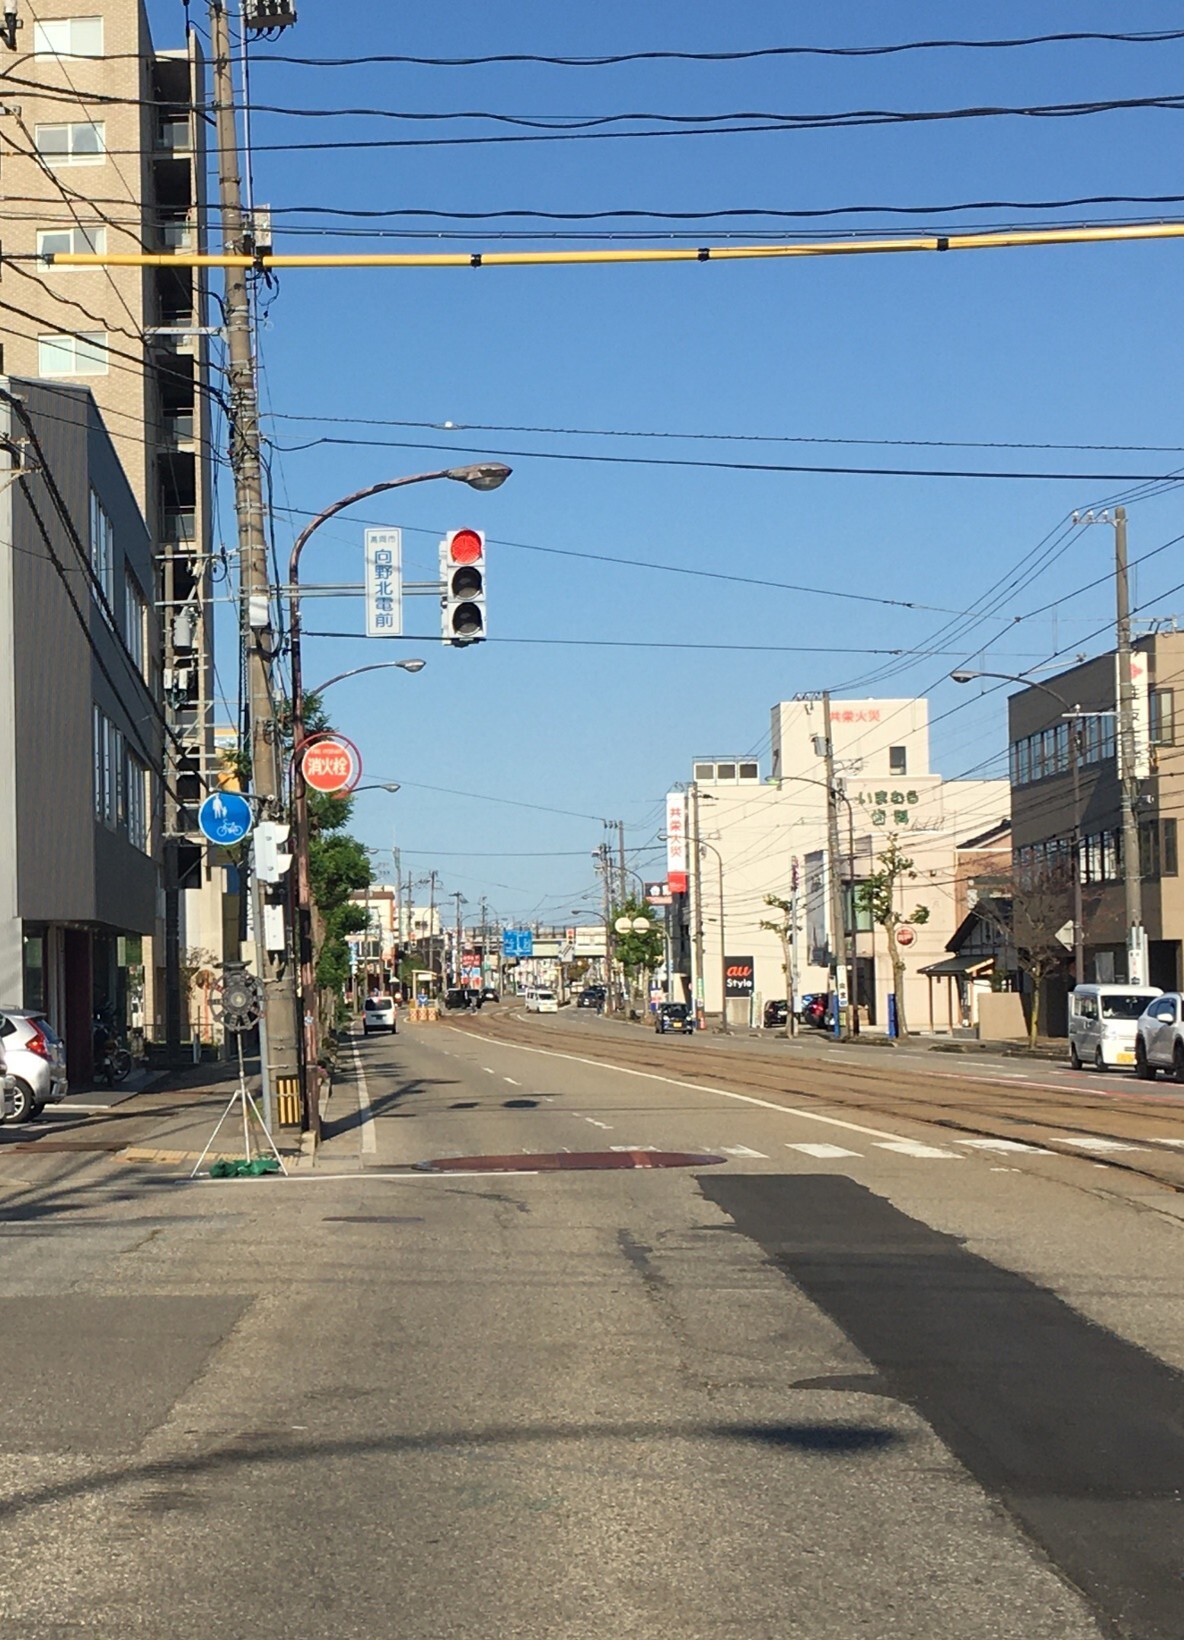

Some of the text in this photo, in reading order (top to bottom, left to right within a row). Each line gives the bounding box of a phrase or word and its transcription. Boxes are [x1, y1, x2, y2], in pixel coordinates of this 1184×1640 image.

[374, 549, 393, 628] 向野北電前
[307, 757, 348, 776] 消火栓
[727, 966, 752, 976] au
[727, 979, 752, 988] Style
